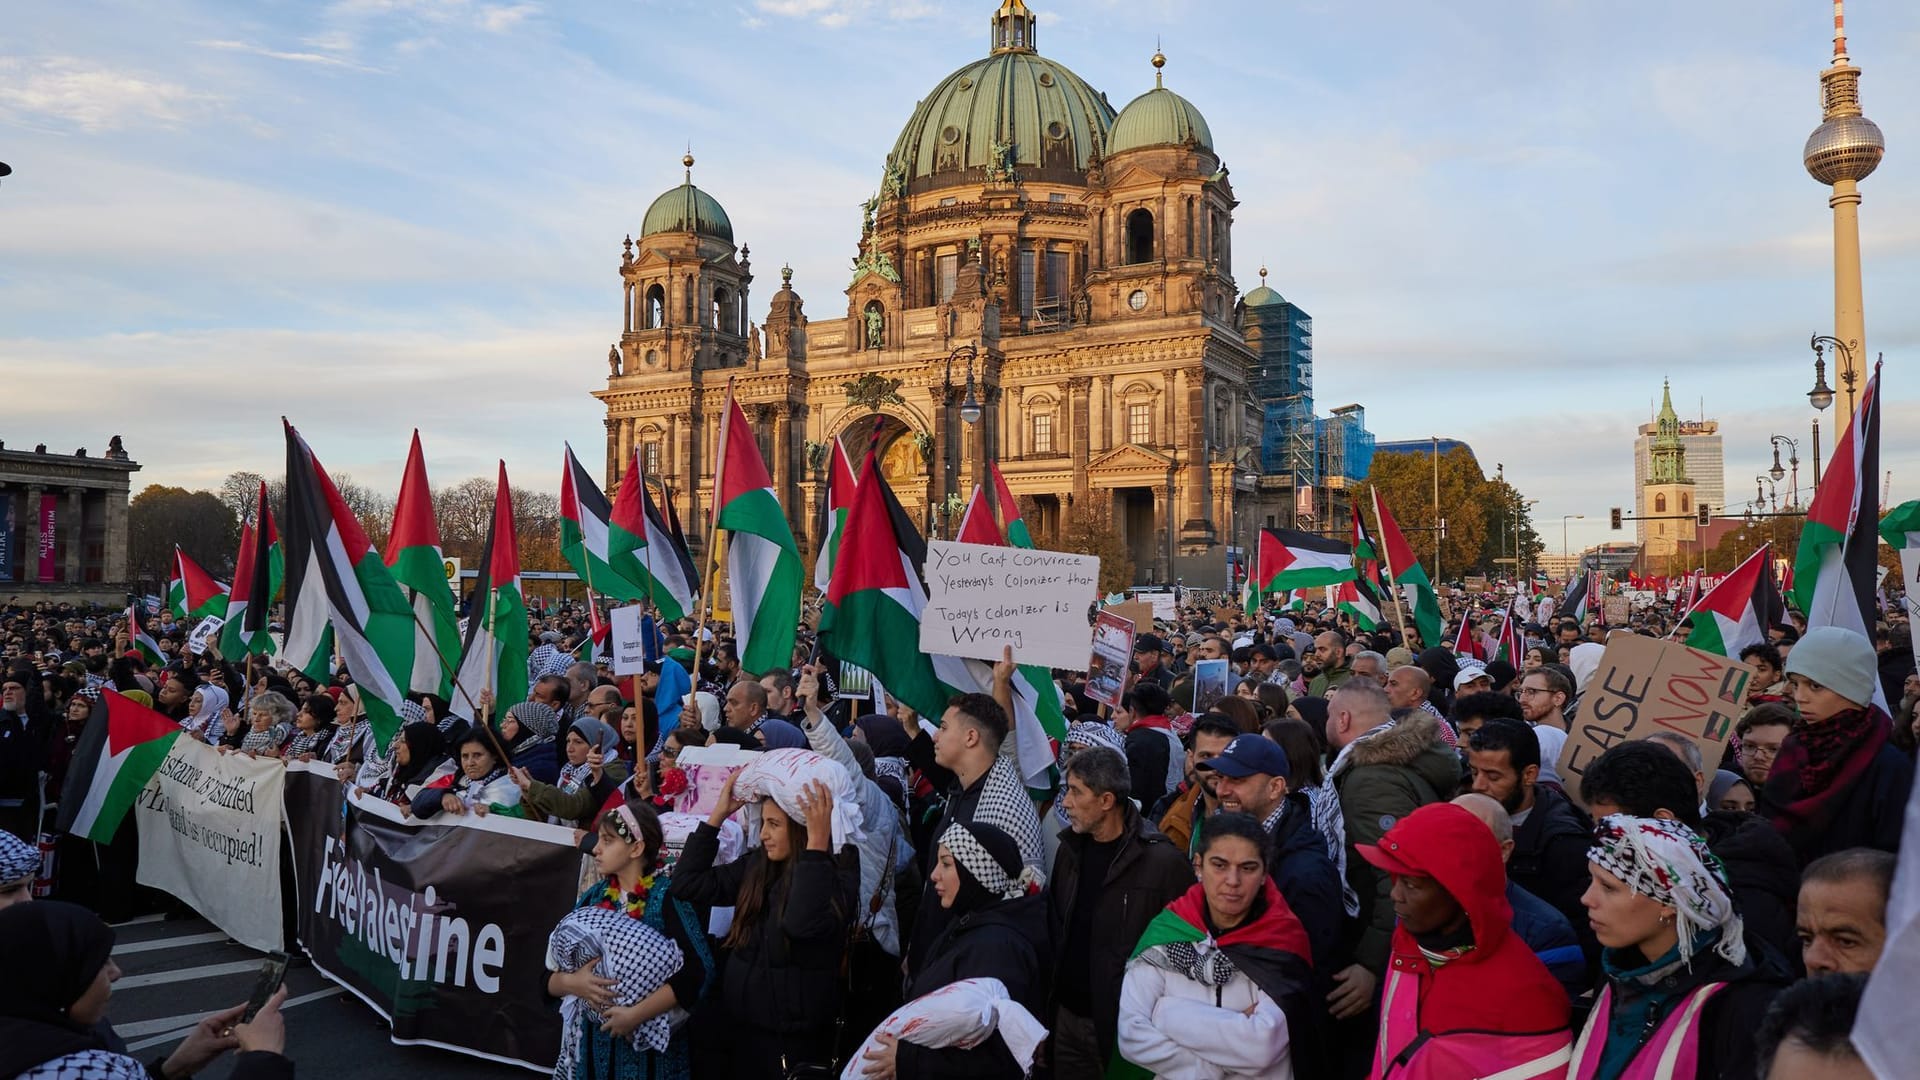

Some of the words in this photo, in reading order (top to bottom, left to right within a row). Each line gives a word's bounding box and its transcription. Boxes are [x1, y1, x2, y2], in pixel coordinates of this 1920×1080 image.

[48, 510, 56, 549] MUSEUM
[1067, 572, 1093, 585] that
[952, 625, 1023, 649] Wrong
[1653, 647, 1723, 739] NOW
[1563, 666, 1652, 780] EASE
[159, 747, 203, 790] istance
